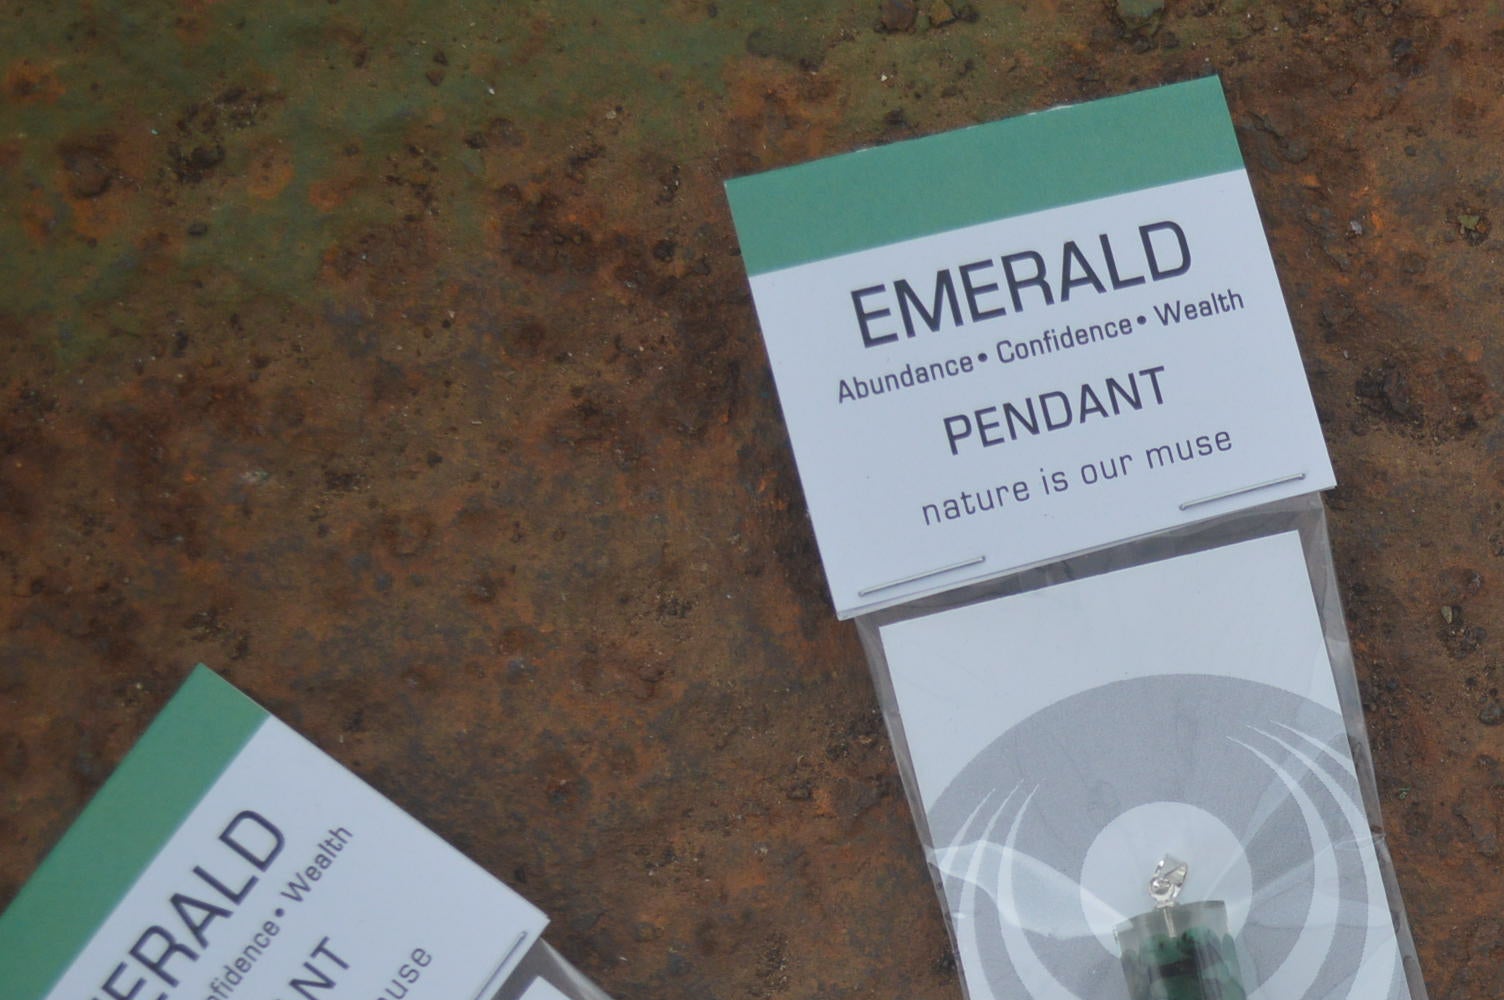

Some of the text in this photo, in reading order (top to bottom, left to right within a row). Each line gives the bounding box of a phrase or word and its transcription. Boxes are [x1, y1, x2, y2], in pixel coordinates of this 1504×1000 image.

[850, 220, 1191, 349] EMERALD
[1153, 288, 1244, 326] Wealth
[943, 365, 1164, 456] PENDANT
[922, 431, 1232, 526] nature is our muse
[280, 827, 352, 902] Wealth
